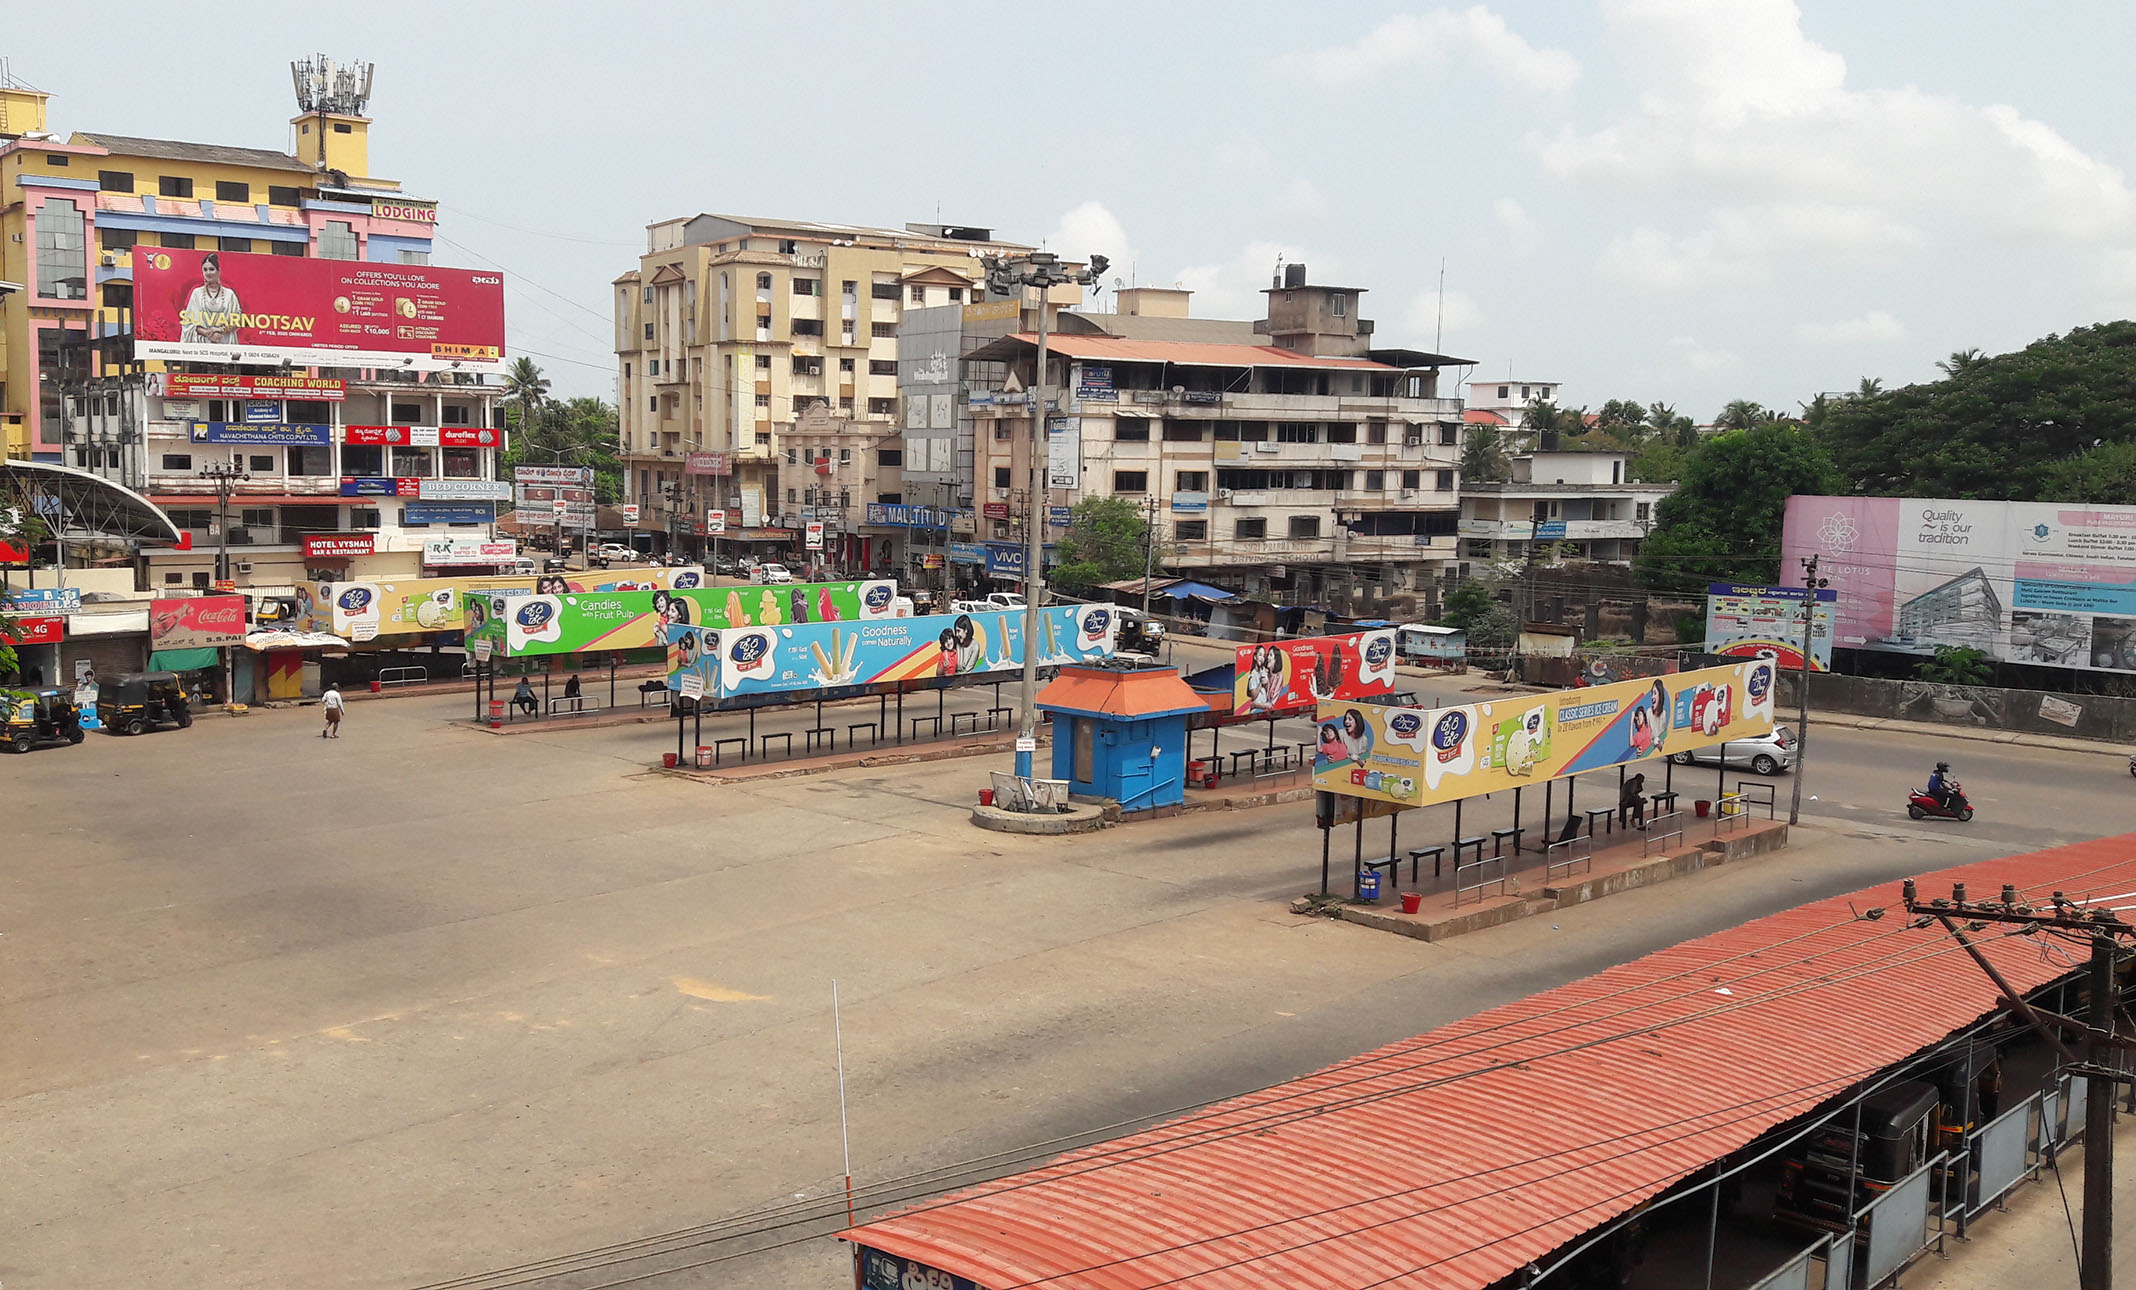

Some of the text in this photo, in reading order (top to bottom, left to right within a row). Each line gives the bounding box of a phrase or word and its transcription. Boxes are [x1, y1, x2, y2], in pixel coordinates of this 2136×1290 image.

[395, 201, 433, 209] INTERNATIONAL
[375, 205, 436, 221] LODGING
[356, 271, 425, 282] OFFERS YOU'LL LOVE
[340, 277, 440, 290] ON COLLECTIONS YOU ADORE
[178, 310, 316, 332] SUVARNOTSAV
[434, 345, 486, 356] BHIMA
[254, 377, 341, 389] COACHING WORLD
[219, 432, 268, 441] NAVACHETHANA
[445, 430, 476, 439] duroflex
[428, 483, 451, 491] BED
[454, 483, 501, 492] CORNER
[1922, 509, 1963, 524] Quality
[1940, 522, 1973, 533] is our
[310, 540, 373, 548] HOTEL VYSHALI
[1918, 532, 1969, 545] tradition
[332, 548, 370, 556] RESTAURANT
[1838, 566, 1871, 576] LOTUS
[869, 588, 892, 600] Dairy
[18, 599, 82, 611] MOBILES
[580, 599, 622, 611] Candies
[872, 596, 888, 607] Day
[594, 610, 614, 620] Fruit
[616, 610, 635, 619] Pulp
[1087, 611, 1106, 623] Dairy
[33, 624, 48, 634] 4G
[1089, 620, 1104, 631] Day
[862, 625, 908, 638] Goodness
[877, 636, 913, 649] Naturally
[1370, 638, 1388, 653] Dairy
[1371, 651, 1387, 662] Day
[1559, 709, 1577, 722] CLASSIC
[1603, 701, 1619, 714] CREAM
[1395, 715, 1416, 727] Dairy
[1401, 724, 1414, 732] Day
